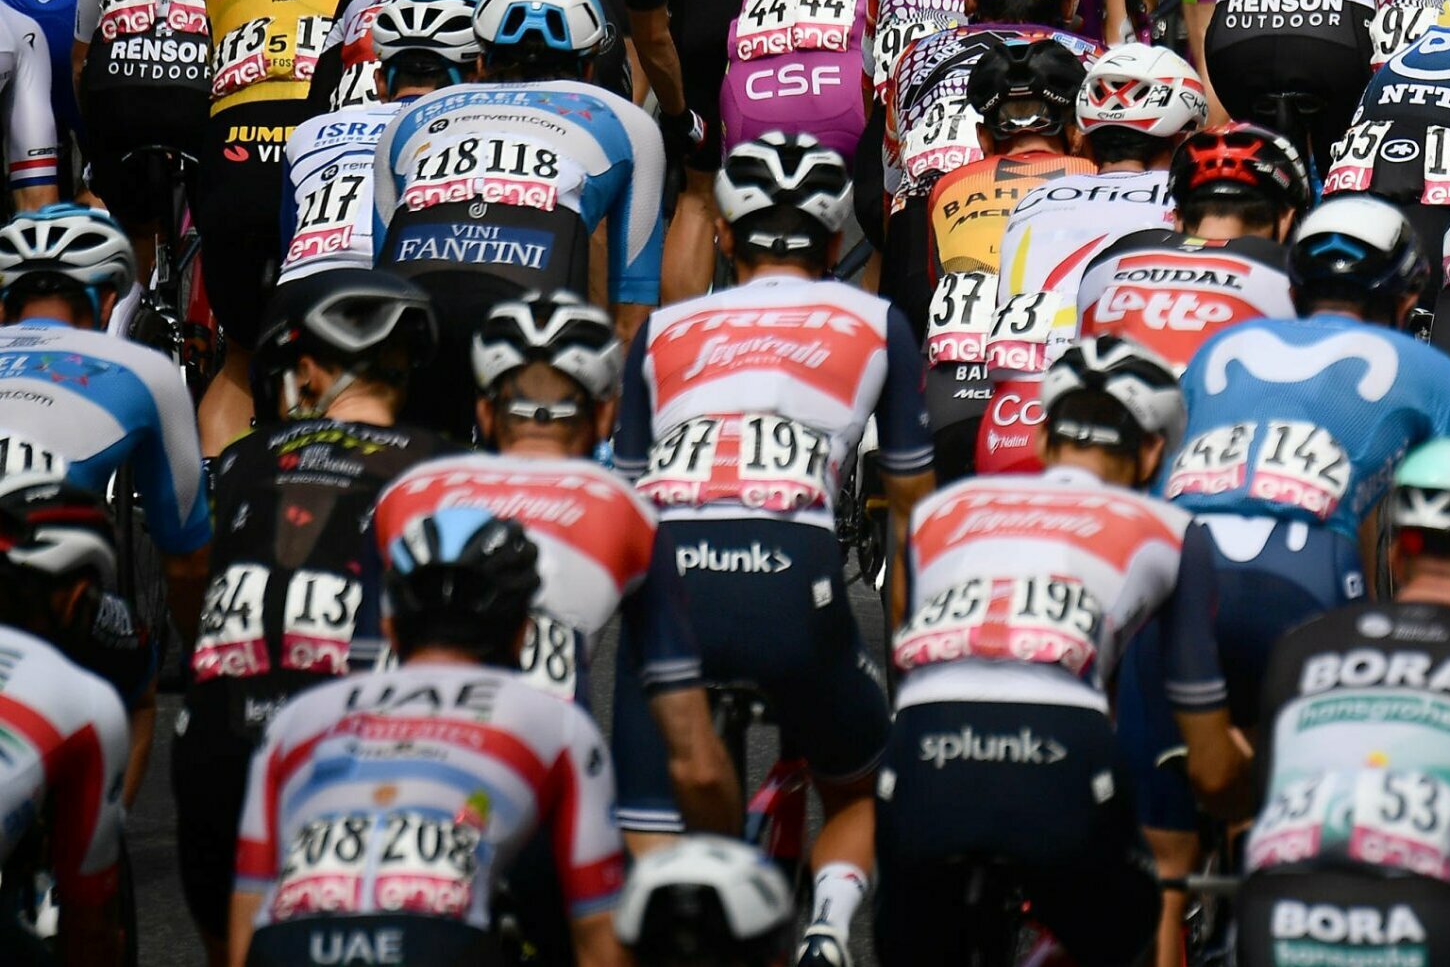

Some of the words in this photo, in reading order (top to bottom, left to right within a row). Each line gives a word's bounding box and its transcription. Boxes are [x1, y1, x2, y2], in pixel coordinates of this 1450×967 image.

[101, 4, 155, 40] enel
[1226, 13, 1341, 29] OUTDOOR
[737, 27, 793, 61] enel
[913, 41, 967, 85] PALACE
[745, 63, 841, 100] CSF
[413, 93, 531, 124] ISRAEL
[453, 114, 567, 136] reinvent.com
[416, 137, 479, 182] 118
[486, 138, 560, 180] 118
[911, 147, 970, 177] enel
[405, 179, 474, 213] enel
[483, 178, 557, 212] enel
[287, 225, 353, 264] enel
[450, 224, 501, 241] VINI
[396, 237, 548, 269] FANTINI
[933, 272, 986, 328] 37
[664, 304, 864, 342] TREK
[682, 336, 833, 383] Segafredo
[1265, 424, 1343, 487] 142
[1380, 771, 1440, 834] 53
[1271, 899, 1428, 945] BORA
[309, 930, 403, 965] UAE
